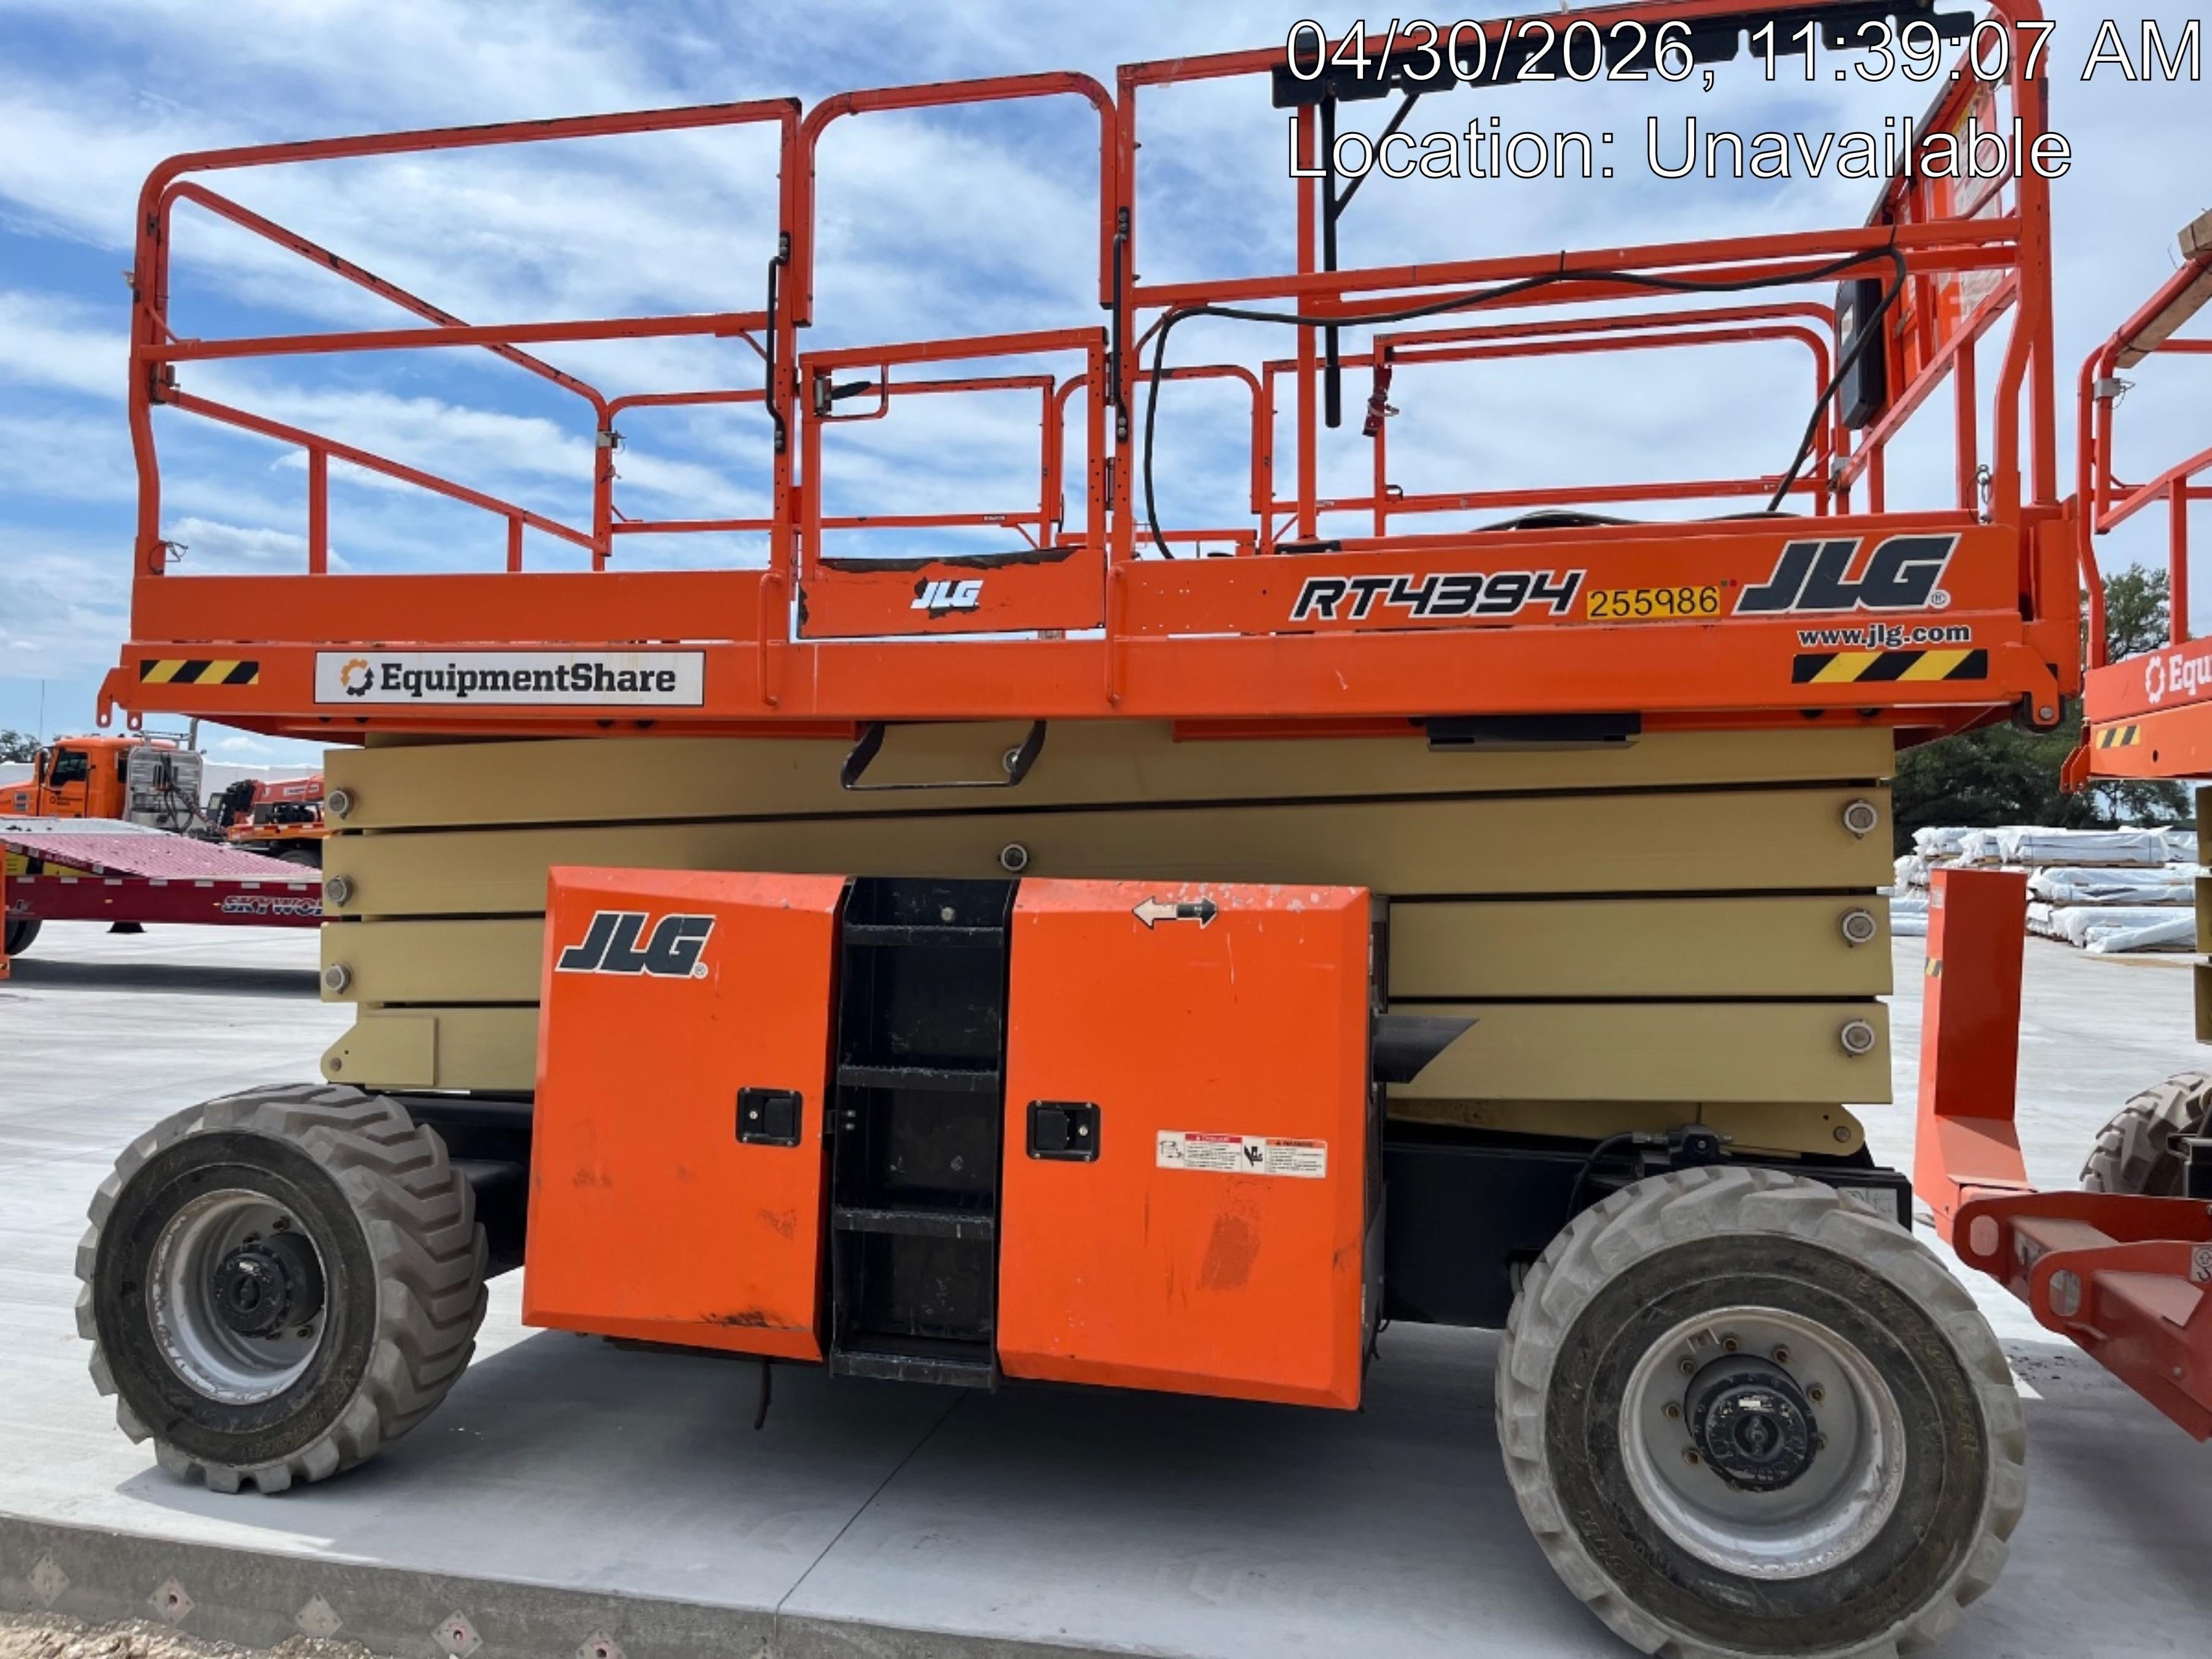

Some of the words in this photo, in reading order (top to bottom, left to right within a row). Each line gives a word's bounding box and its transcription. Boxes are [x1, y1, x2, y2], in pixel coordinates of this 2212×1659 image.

[1733, 533, 1962, 614] JLG
[911, 580, 984, 609] JLG
[1288, 569, 1587, 621] RT4394
[1590, 585, 1719, 618] 255986
[1798, 623, 1972, 649] www.jlg.com
[380, 663, 677, 697] EquipmentShare
[2169, 654, 2212, 695] Equ
[555, 911, 716, 978] JLG
